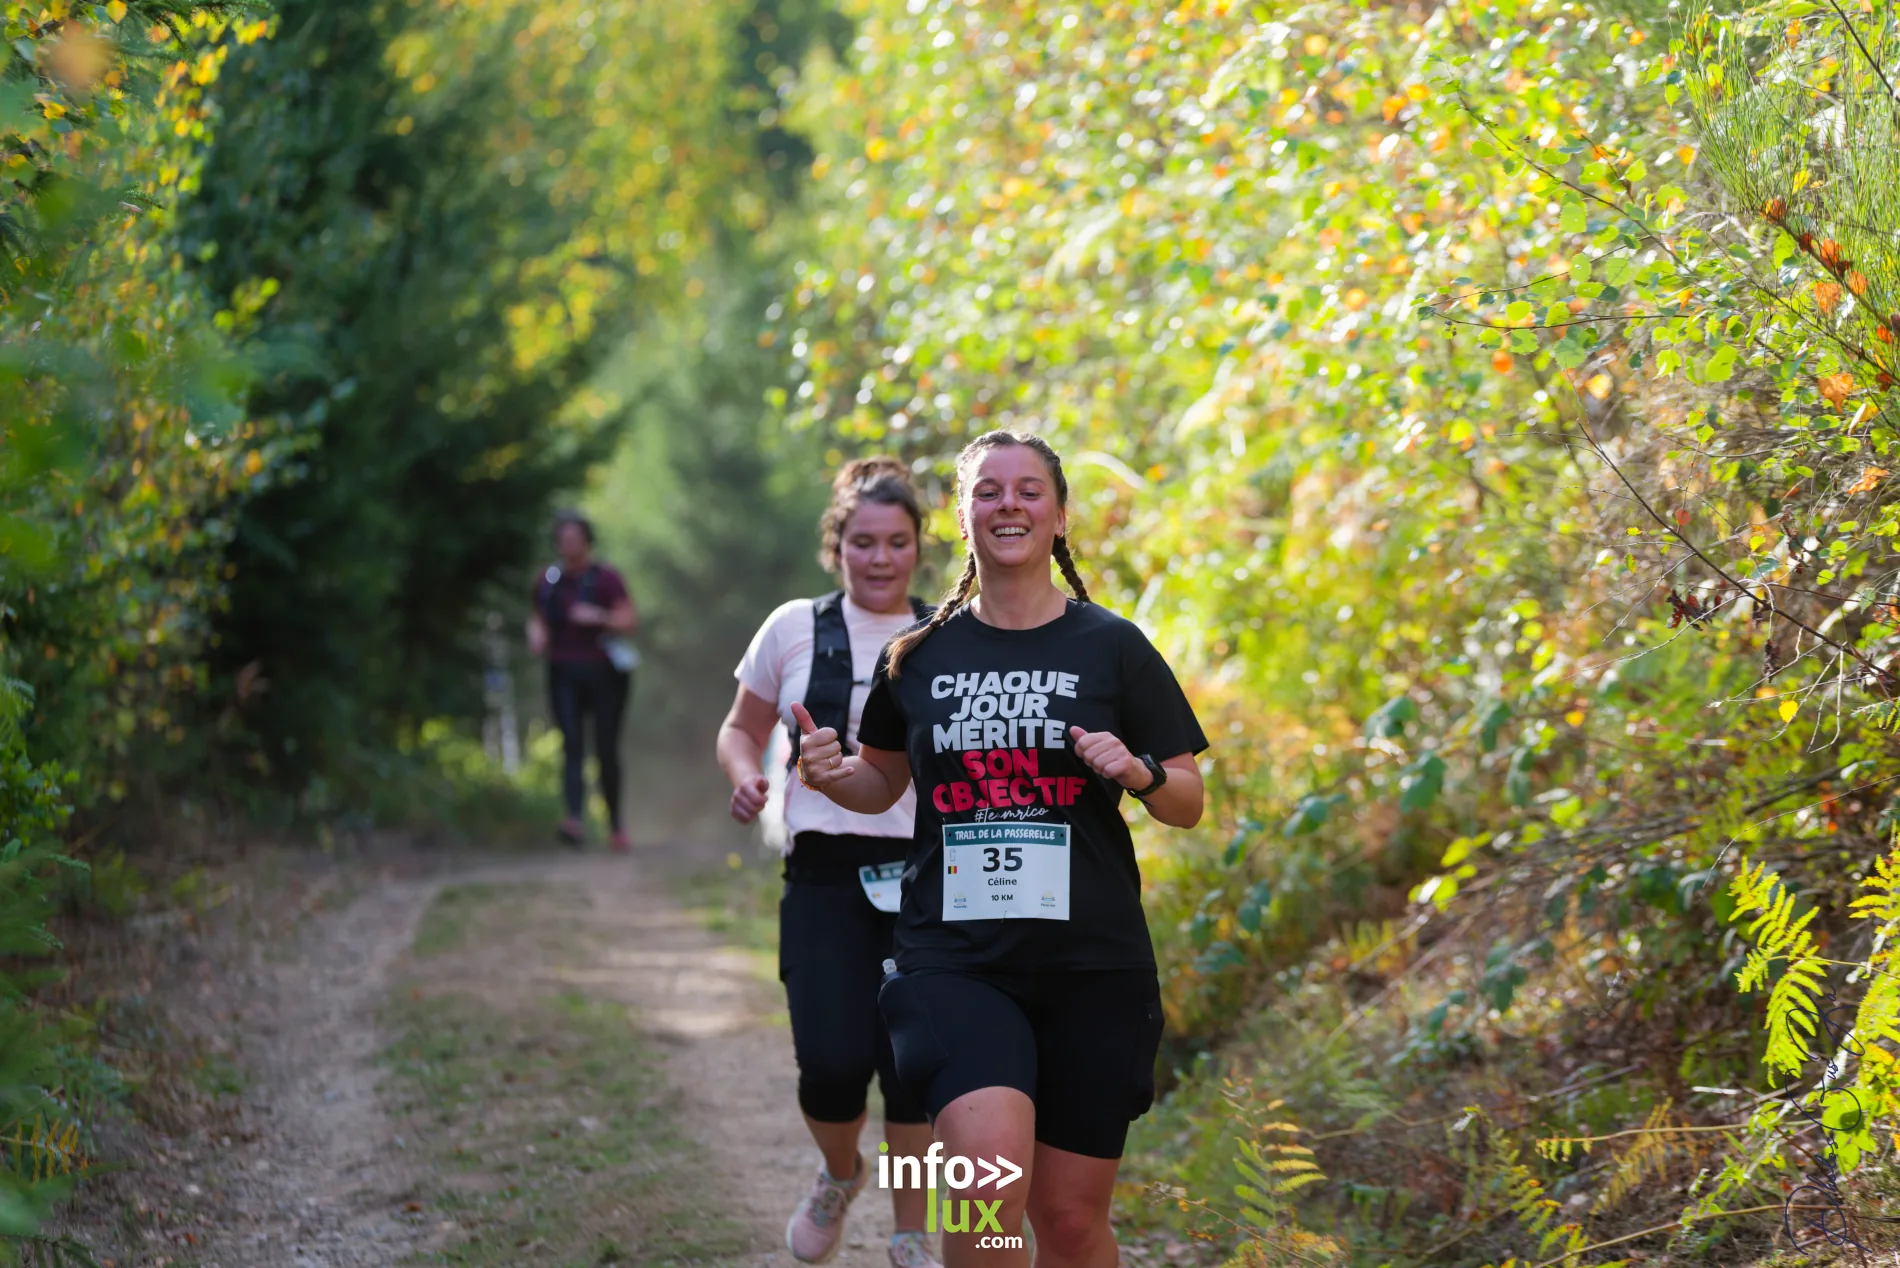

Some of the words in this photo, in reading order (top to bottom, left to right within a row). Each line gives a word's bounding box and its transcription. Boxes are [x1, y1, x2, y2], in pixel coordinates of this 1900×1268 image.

[931, 670, 1080, 699] CHAQUE
[949, 693, 1049, 721] JOUR
[933, 716, 1066, 753] MÉRITE
[962, 749, 1039, 780] SON
[933, 777, 1087, 813] OBJECTIF
[955, 830, 976, 840] TRAIL
[978, 829, 989, 839] DE
[991, 829, 1002, 838] LA
[1004, 828, 1056, 840] PASSERELLE
[982, 847, 1023, 872] 35
[988, 877, 1017, 886] Céline
